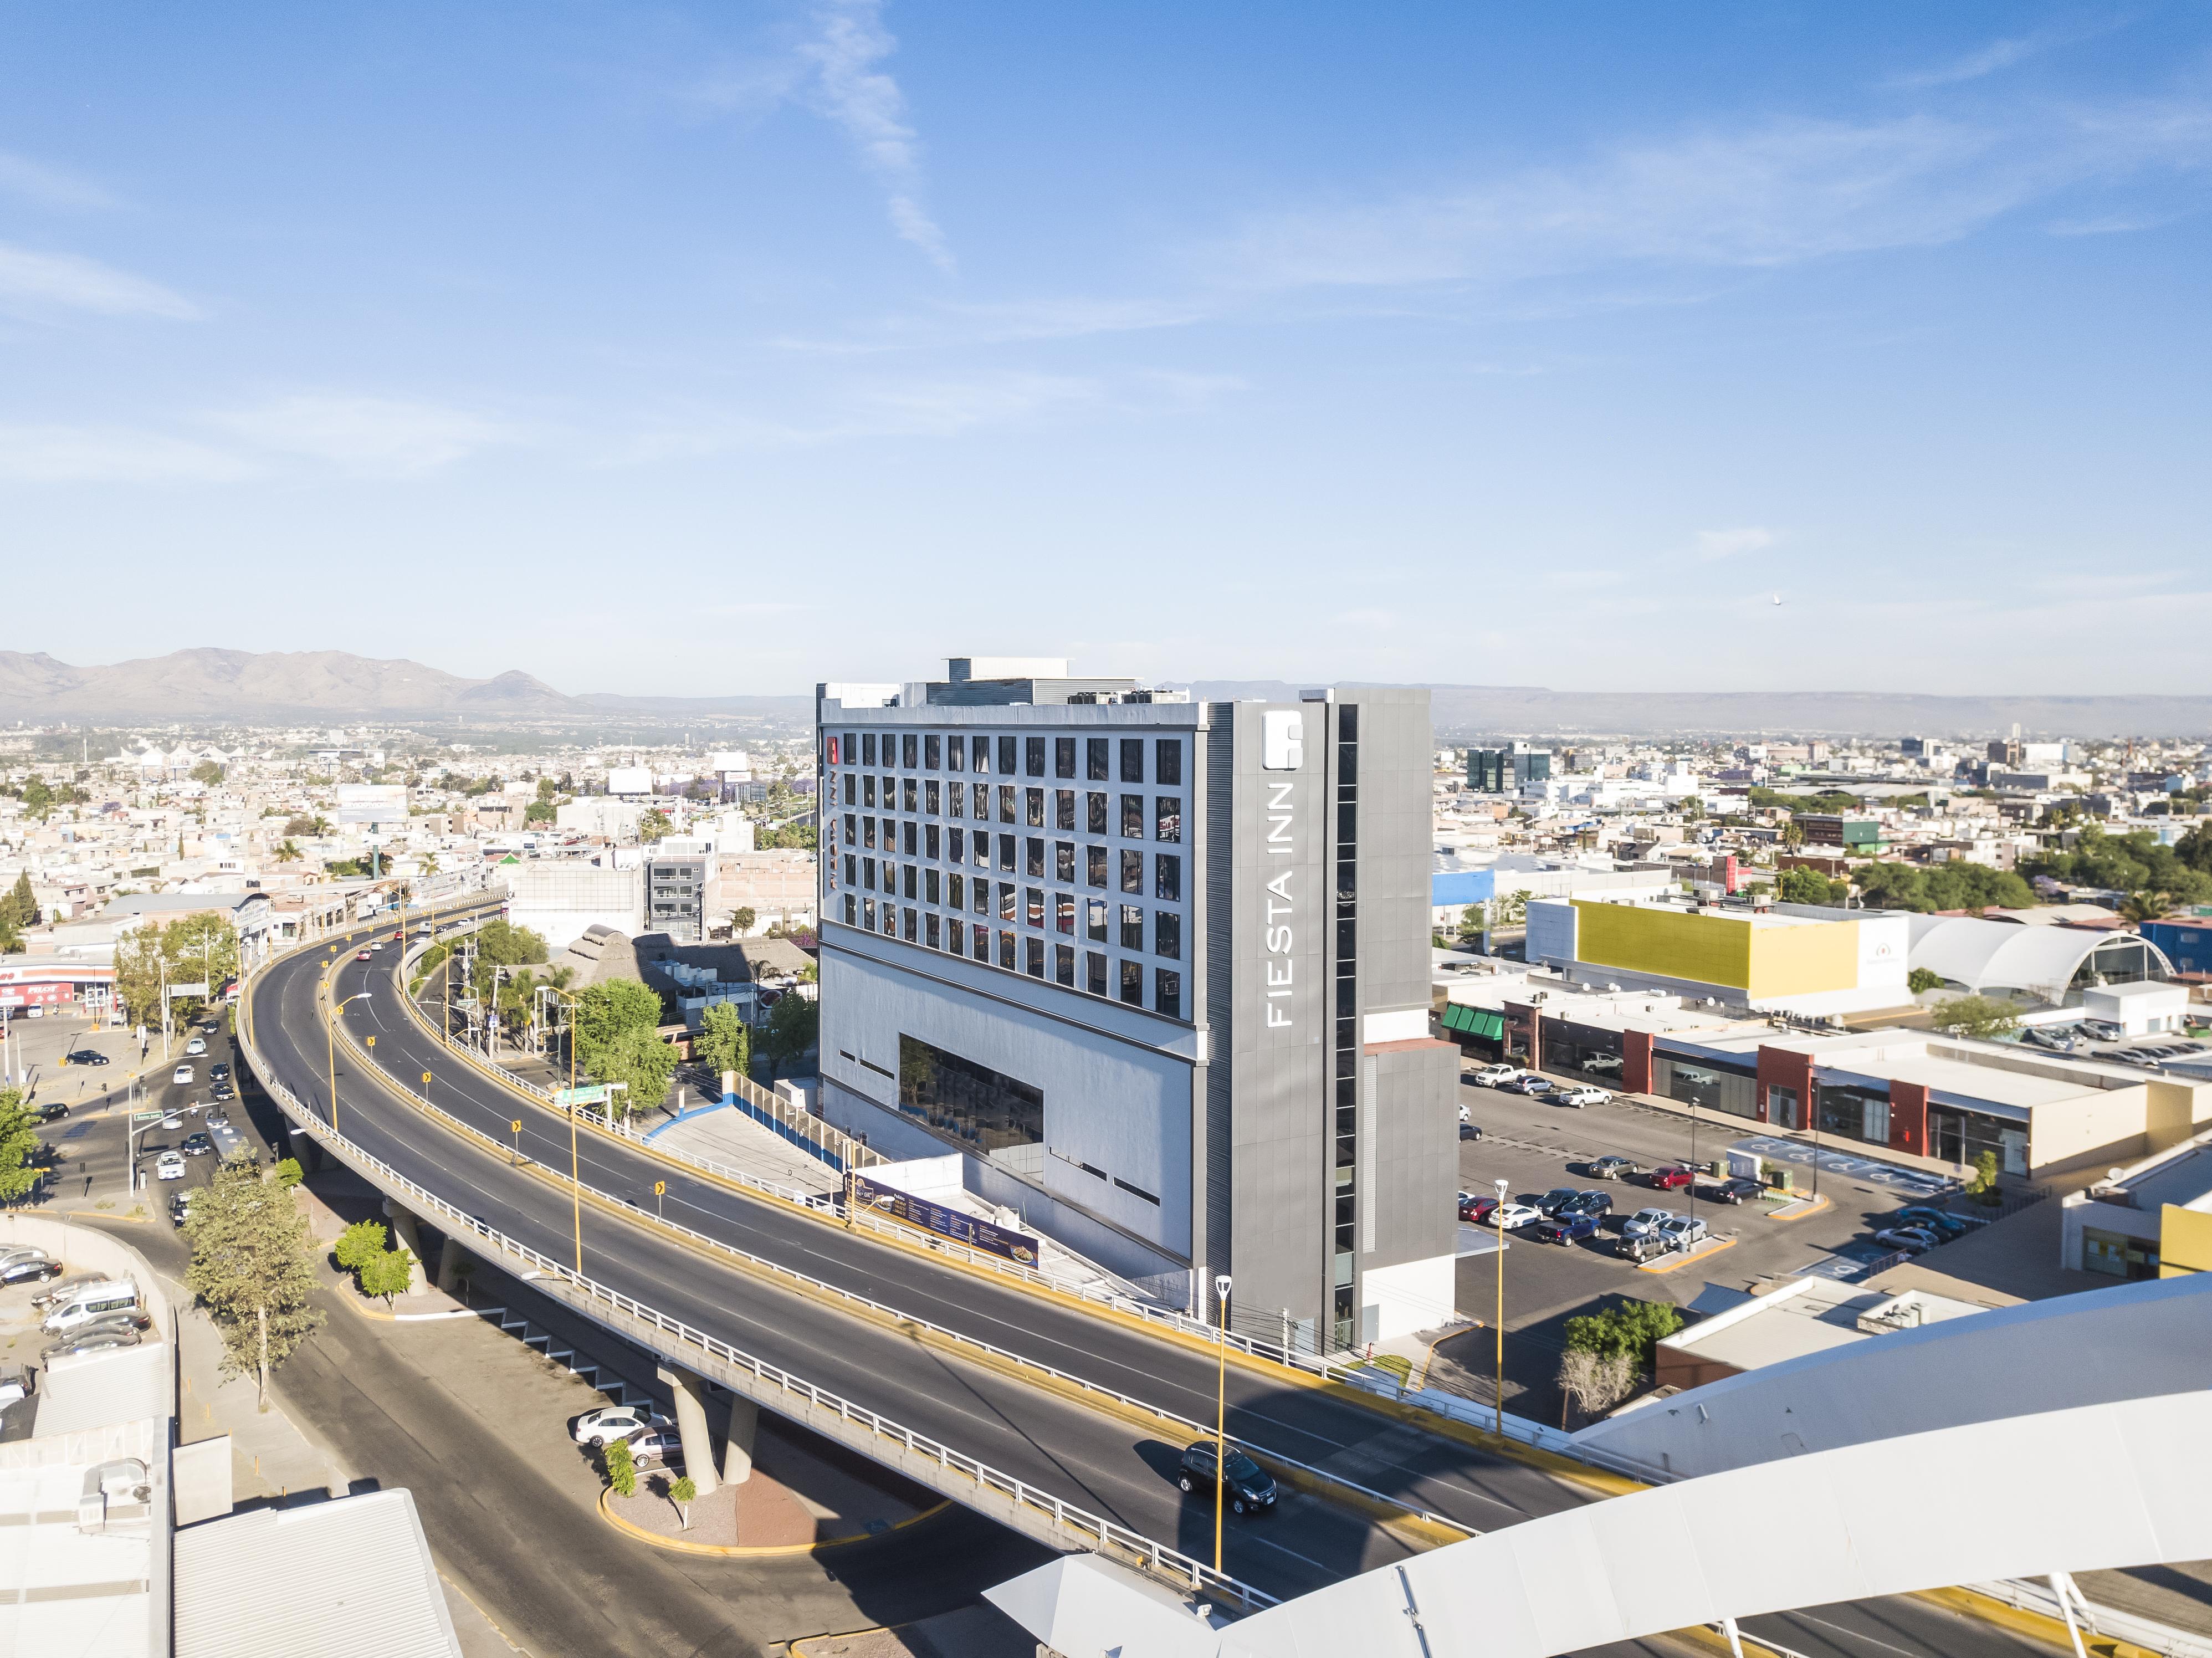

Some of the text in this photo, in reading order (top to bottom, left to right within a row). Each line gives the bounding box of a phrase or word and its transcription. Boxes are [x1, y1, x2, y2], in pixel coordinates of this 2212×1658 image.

[1267, 783, 1293, 1028] FIESTA INN
[28, 985, 59, 994] PILOT
